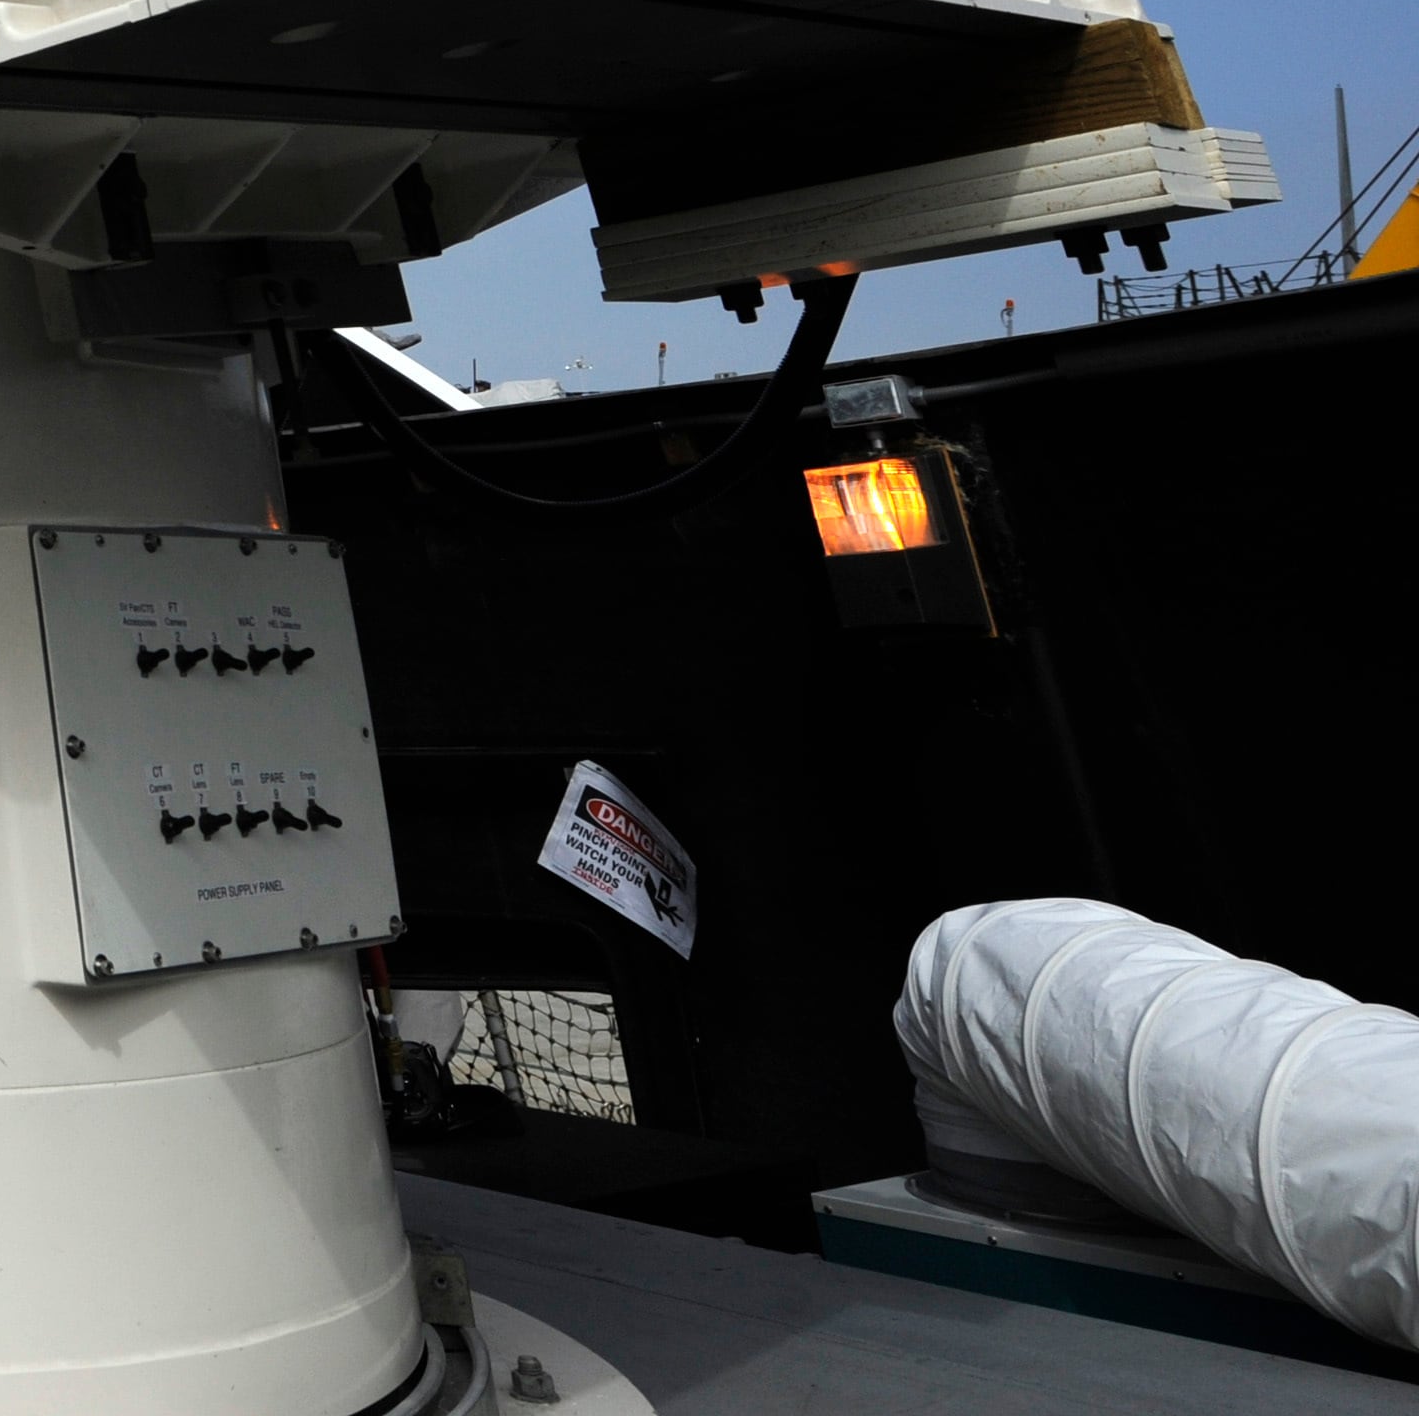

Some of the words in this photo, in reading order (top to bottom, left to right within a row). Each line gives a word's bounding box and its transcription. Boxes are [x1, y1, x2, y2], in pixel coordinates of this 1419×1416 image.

[152, 766, 163, 778] CT
[193, 763, 204, 775] CT
[231, 762, 240, 773] FT
[259, 772, 285, 784] SPARE
[571, 822, 608, 850] PINCH
[597, 803, 683, 880] DANGER
[566, 834, 608, 866] WATCH
[611, 860, 644, 888] YOUR
[577, 858, 620, 889] HANDS
[197, 886, 228, 901] POWER
[228, 882, 259, 897] SUPPLY
[259, 879, 284, 893] PANEL
